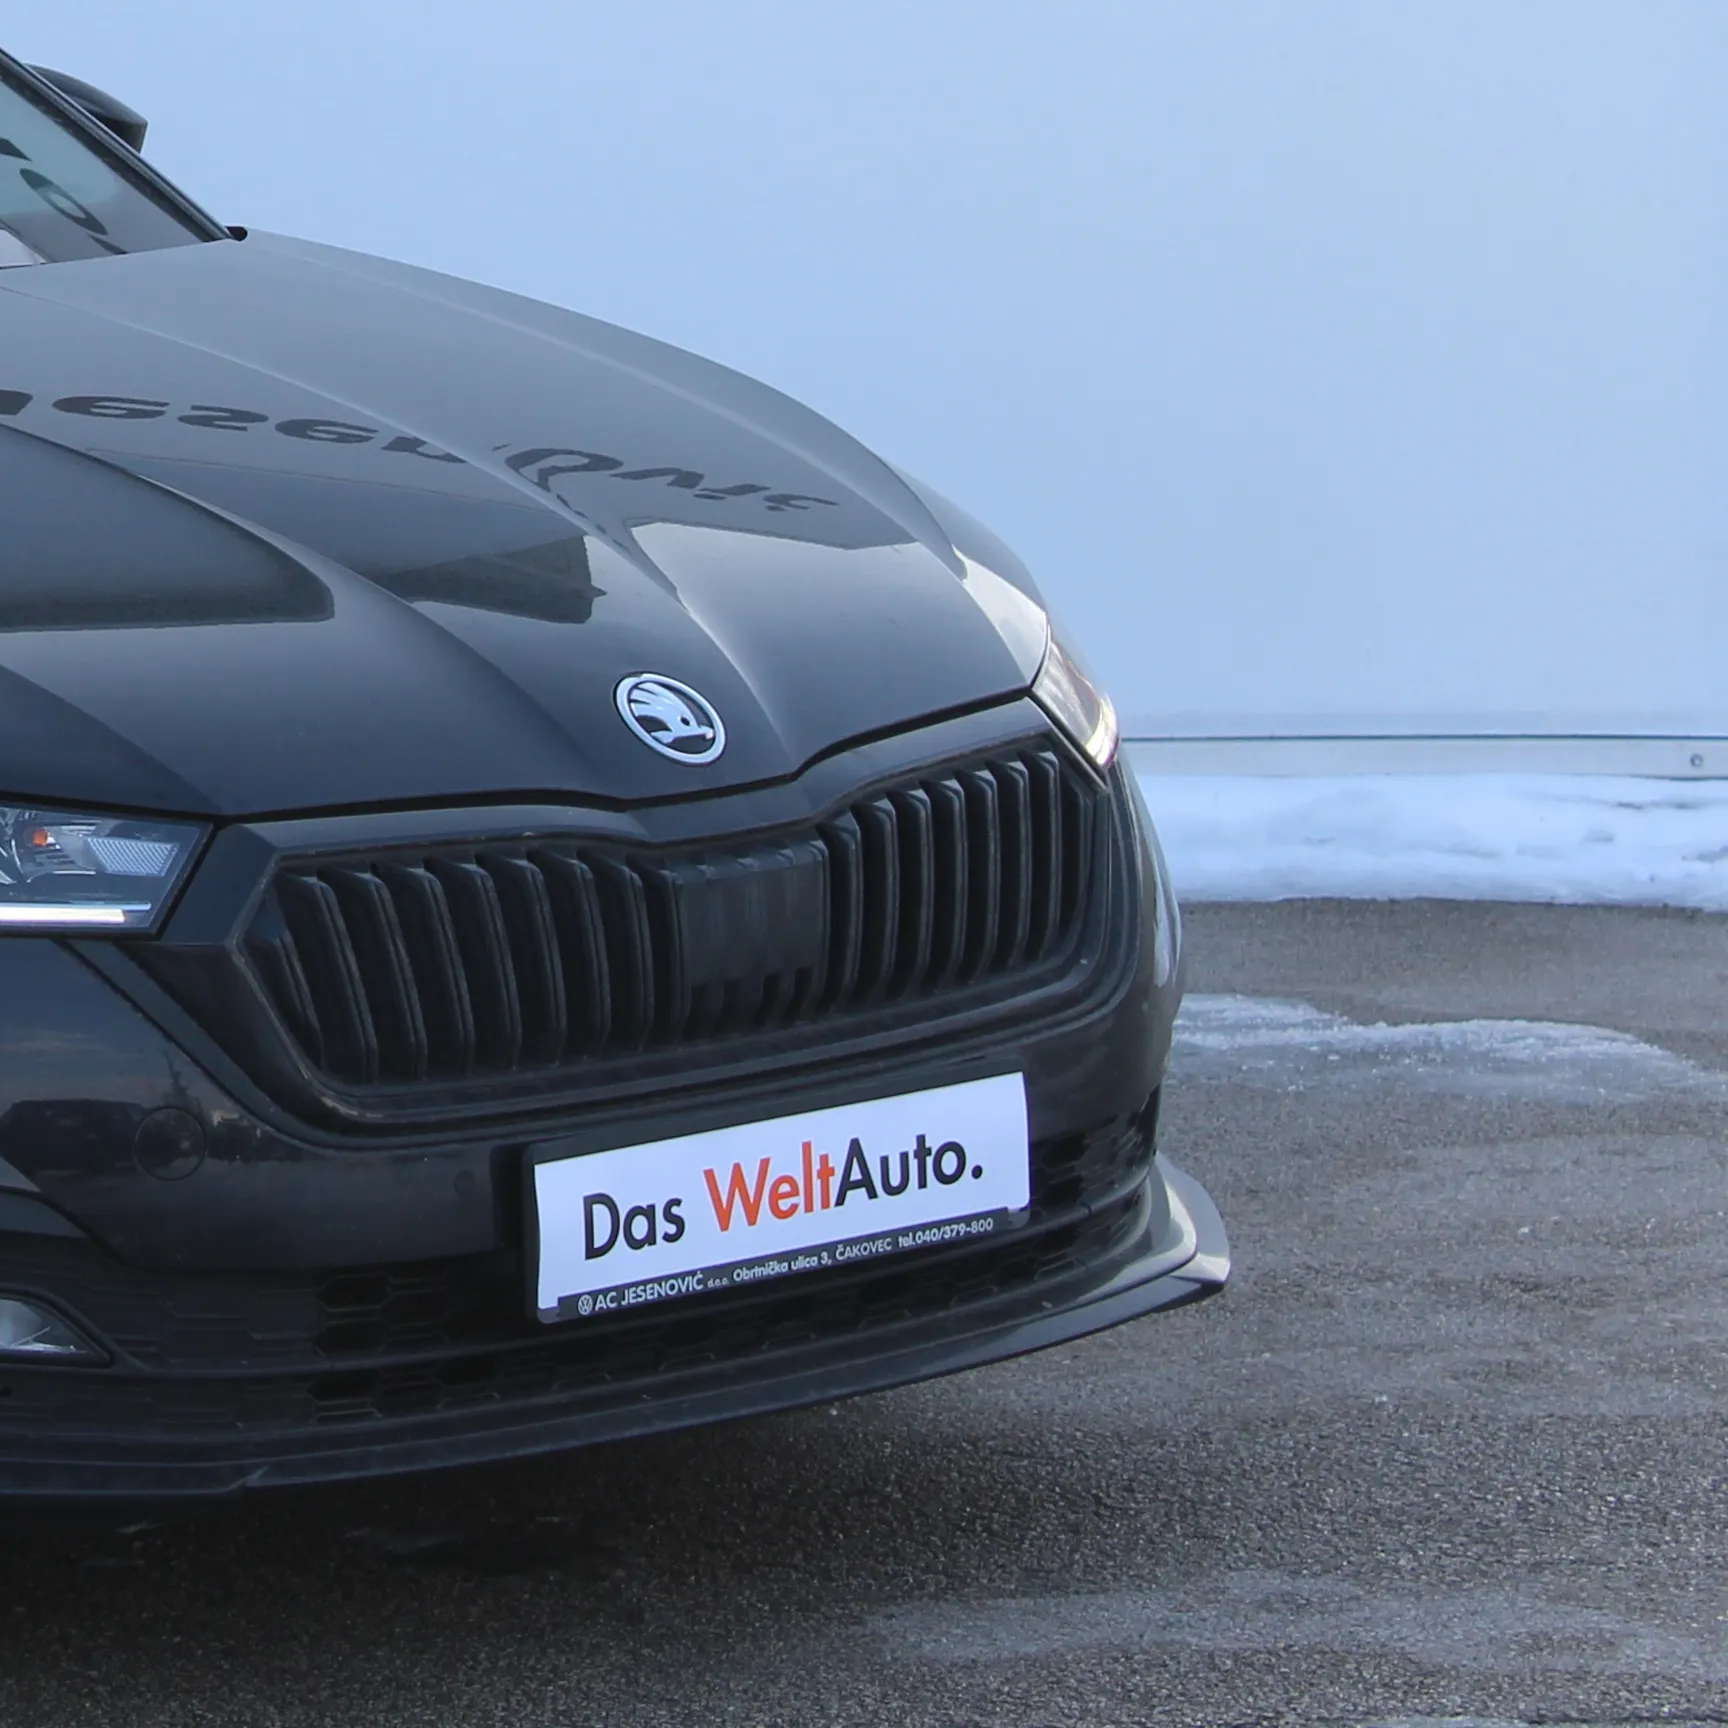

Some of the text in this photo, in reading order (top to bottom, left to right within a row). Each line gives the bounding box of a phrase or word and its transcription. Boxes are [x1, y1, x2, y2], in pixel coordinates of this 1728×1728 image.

[583, 1133, 984, 1261] Das WeltAuto.
[594, 1292, 618, 1312] AC
[621, 1271, 704, 1306] JESENOVIĆ
[733, 1260, 789, 1282] Obrtnička
[791, 1255, 818, 1271] ulica
[835, 1237, 893, 1261] ČAKOVEC
